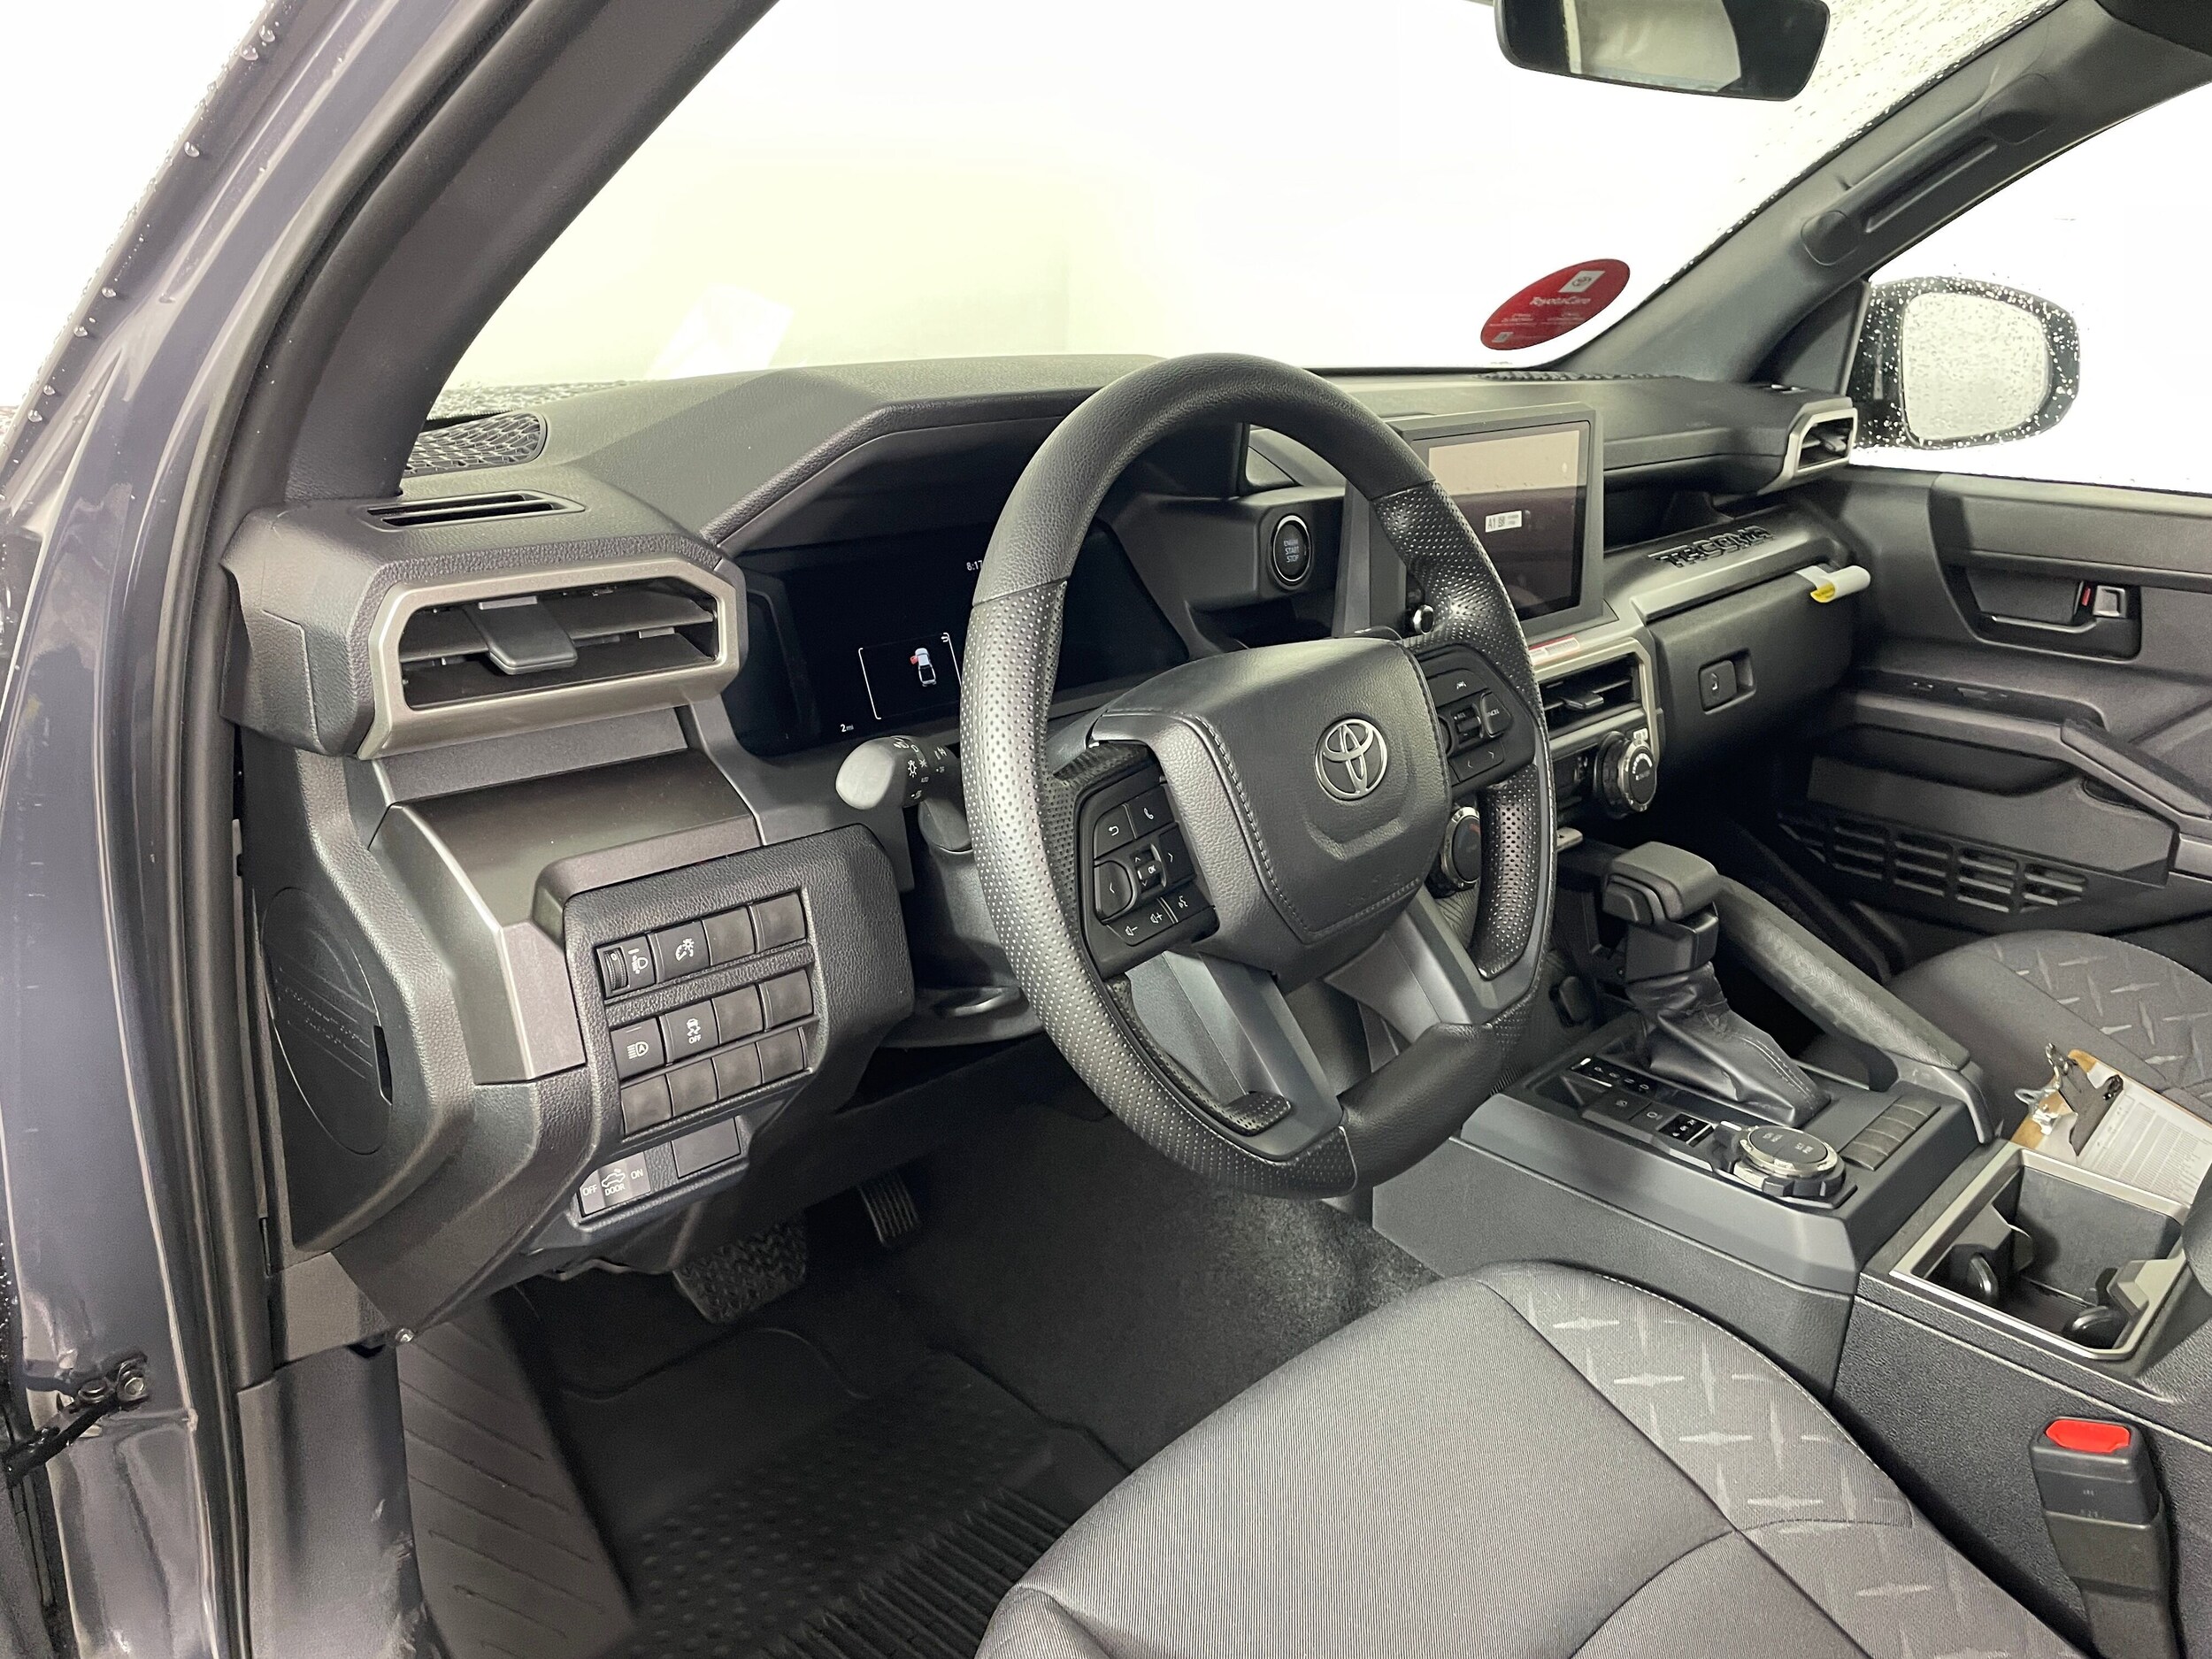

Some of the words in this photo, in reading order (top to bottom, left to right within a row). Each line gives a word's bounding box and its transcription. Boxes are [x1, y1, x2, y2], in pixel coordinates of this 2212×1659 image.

[1529, 296, 1591, 306] ToyotaCare
[1285, 546, 1300, 556] START
[1286, 554, 1300, 563] STOP
[688, 1033, 702, 1045] OFF
[630, 1168, 644, 1179] ON
[582, 1184, 598, 1196] OFF
[604, 1183, 626, 1196] DOOR
